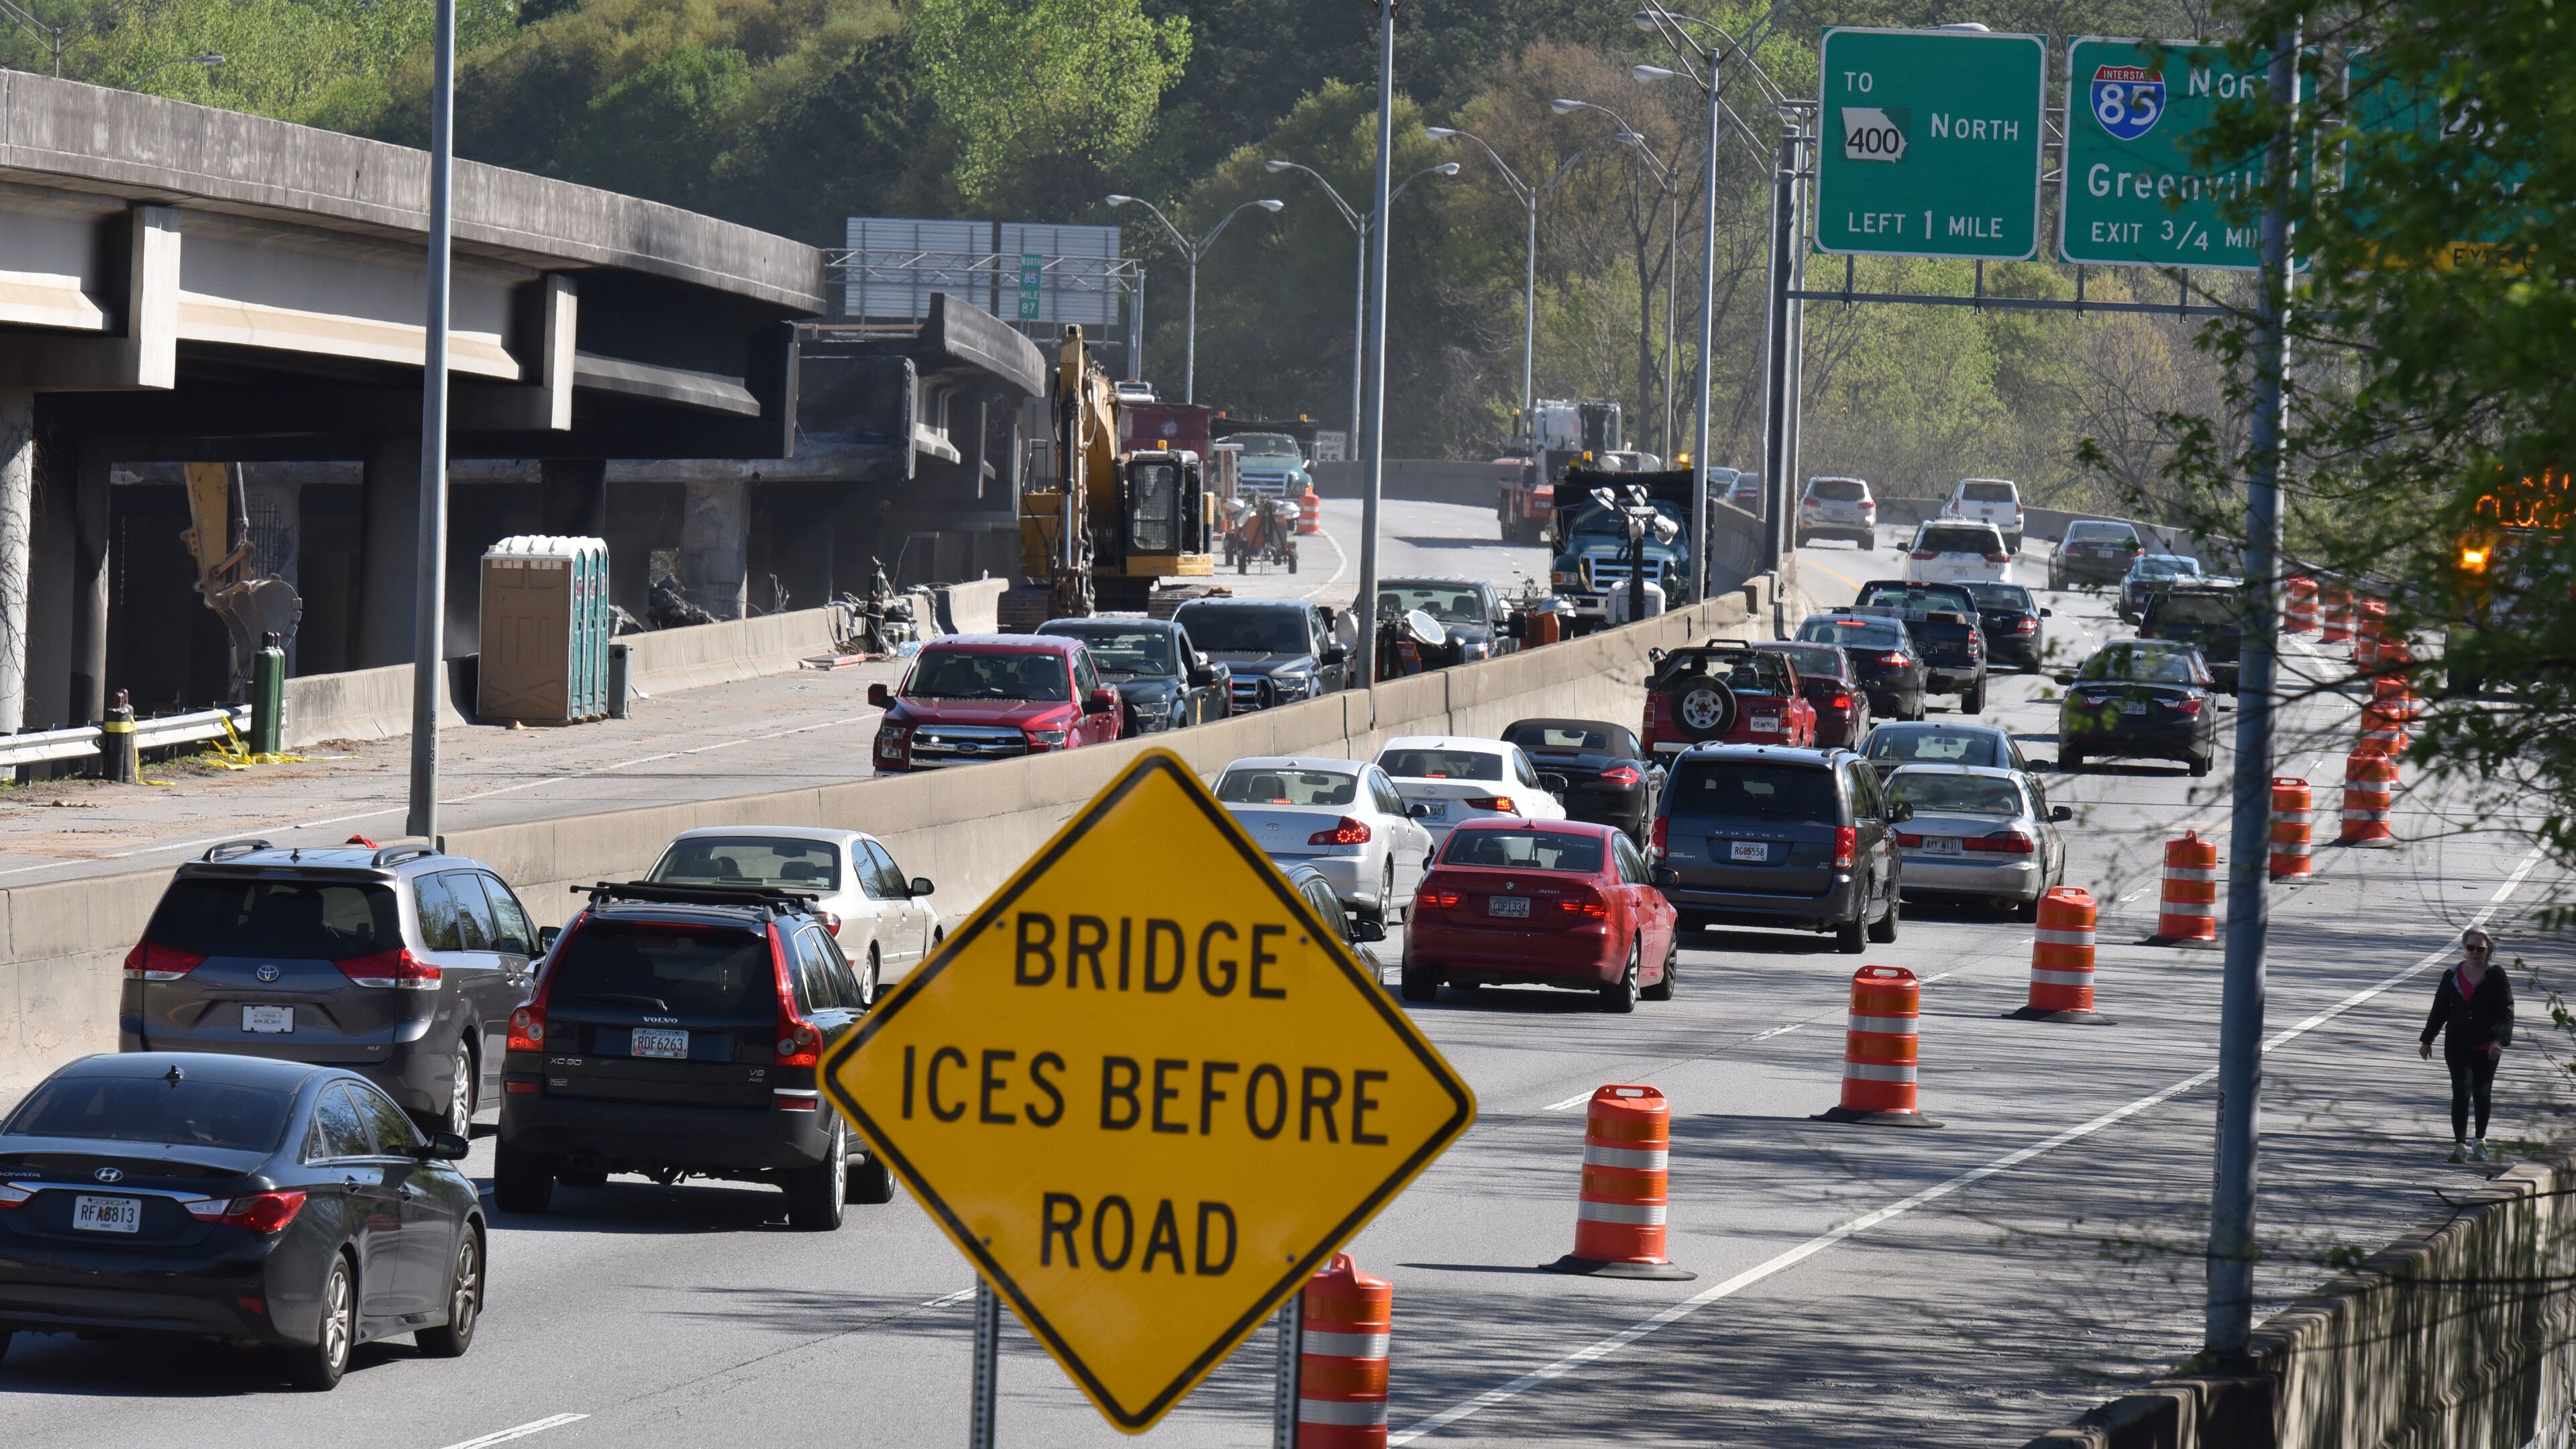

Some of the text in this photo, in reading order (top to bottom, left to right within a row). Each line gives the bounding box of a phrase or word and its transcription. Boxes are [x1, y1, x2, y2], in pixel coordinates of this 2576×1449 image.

[1844, 72, 1873, 93] TO
[2104, 70, 2154, 81] INTERSTA
[2189, 68, 2270, 99] NOR
[2098, 84, 2157, 125] 85
[1931, 113, 2019, 140] NORTH
[1847, 127, 1900, 154] 400
[1848, 210, 2004, 239] LEFT 1 MILE
[2092, 221, 2143, 244] EXIT
[2160, 220, 2209, 251] 3/4
[1021, 257, 1041, 267] NORTH
[1024, 274, 1036, 284] 85
[1020, 290, 1039, 300] MILE
[1021, 303, 1036, 314] 87
[1715, 830, 1785, 838] DODGE
[1015, 912, 1287, 1000] BRIDGE
[638, 1036, 683, 1051] RDF6263
[902, 1045, 1389, 1146] ICES BEFORE
[91, 1198, 125, 1206] GEORGIA
[80, 1205, 135, 1223] RFA8813
[1041, 1191, 1238, 1277] ROAD
